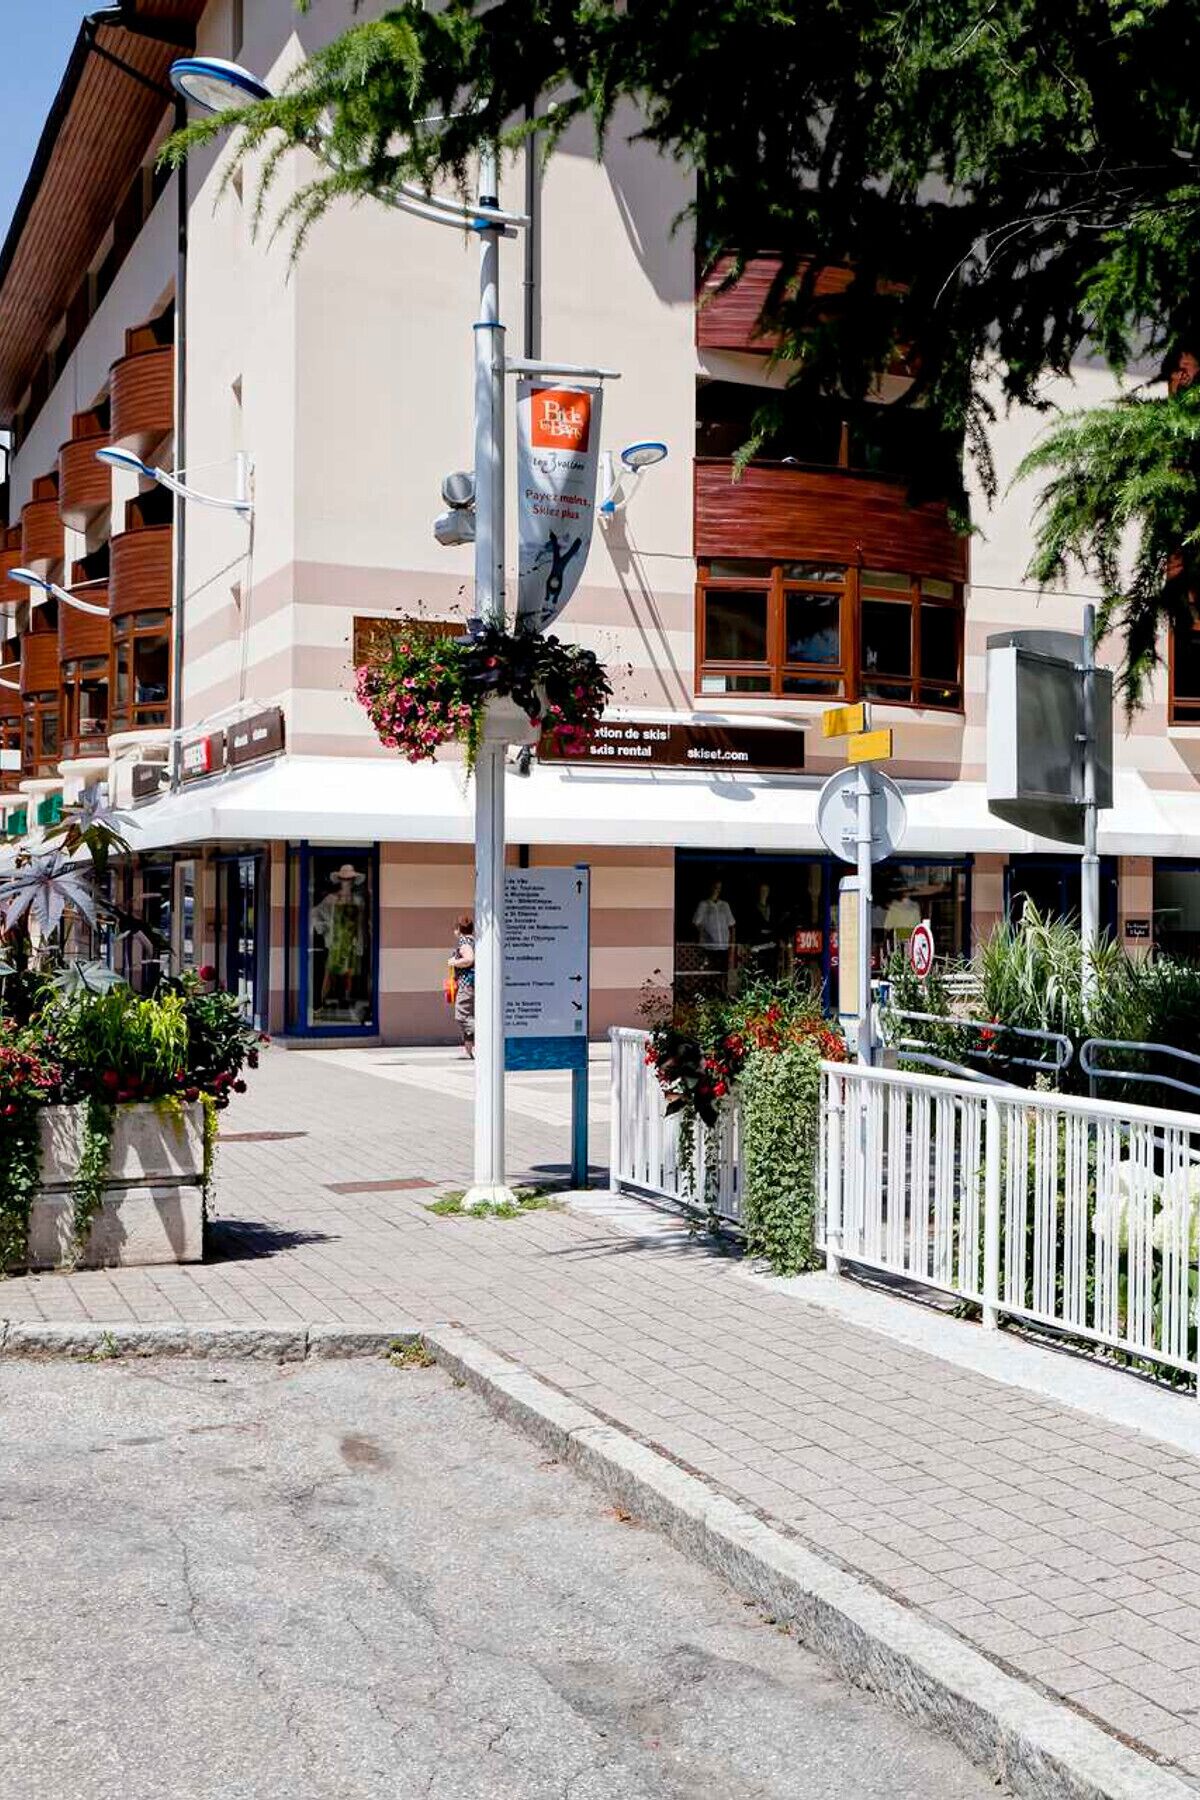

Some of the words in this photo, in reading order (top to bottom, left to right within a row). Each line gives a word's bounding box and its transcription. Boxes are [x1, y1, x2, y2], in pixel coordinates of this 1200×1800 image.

[625, 728, 640, 740] de
[643, 728, 667, 741] skis
[617, 745, 652, 757] rental
[687, 746, 749, 761] skiset.com
